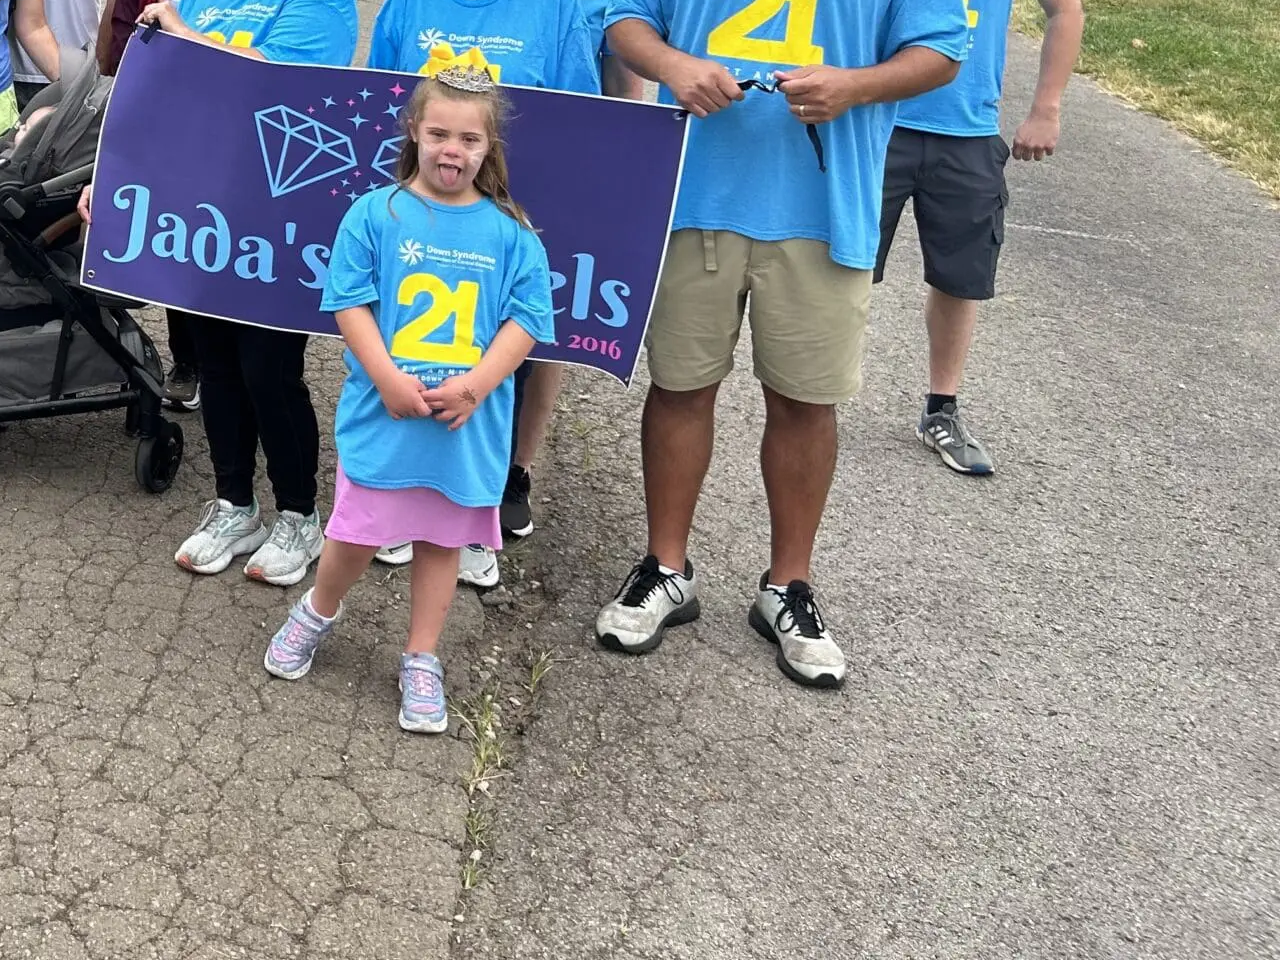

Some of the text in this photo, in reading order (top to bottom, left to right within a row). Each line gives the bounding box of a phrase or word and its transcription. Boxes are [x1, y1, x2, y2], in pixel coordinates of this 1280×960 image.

[448, 33, 476, 43] Down
[477, 36, 524, 48] Syndrome
[102, 184, 331, 289] Jada's
[426, 244, 496, 265] Down Syndrome
[390, 273, 482, 367] 21
[567, 334, 622, 360] 2016
